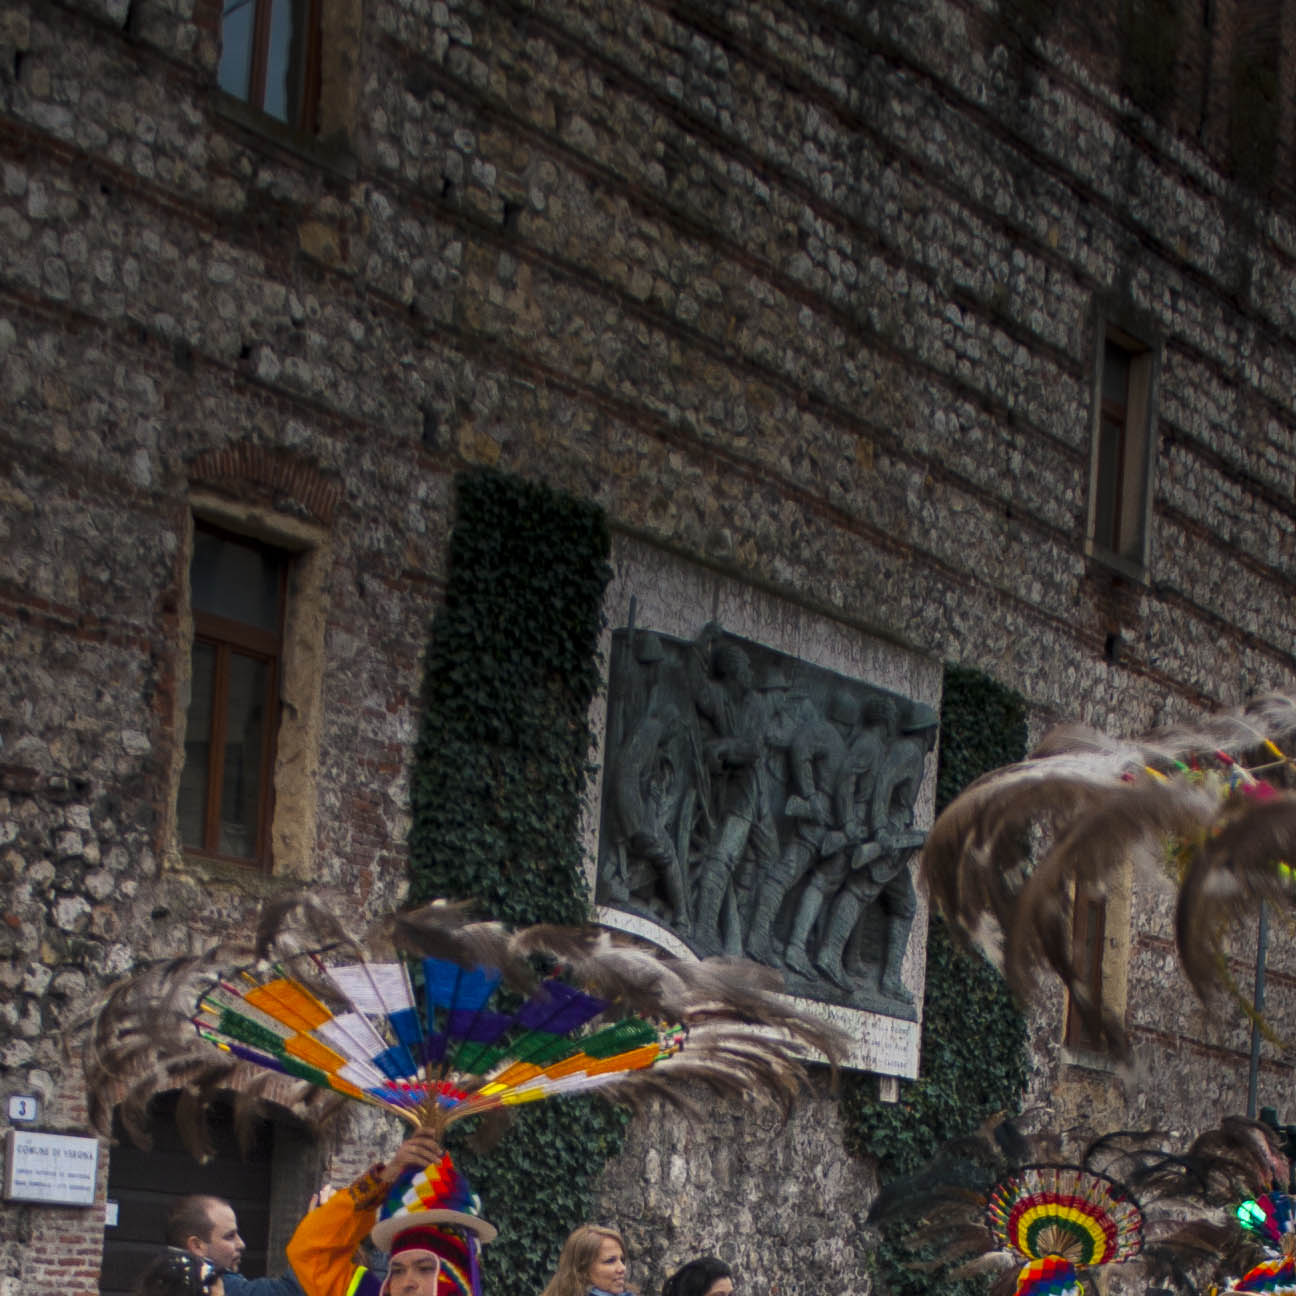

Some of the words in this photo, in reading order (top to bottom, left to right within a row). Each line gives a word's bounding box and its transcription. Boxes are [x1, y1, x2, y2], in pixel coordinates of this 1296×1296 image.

[18, 1100, 26, 1116] 3
[16, 1144, 49, 1155] COMUNE
[52, 1147, 61, 1157] DI
[64, 1149, 94, 1160] VERONA
